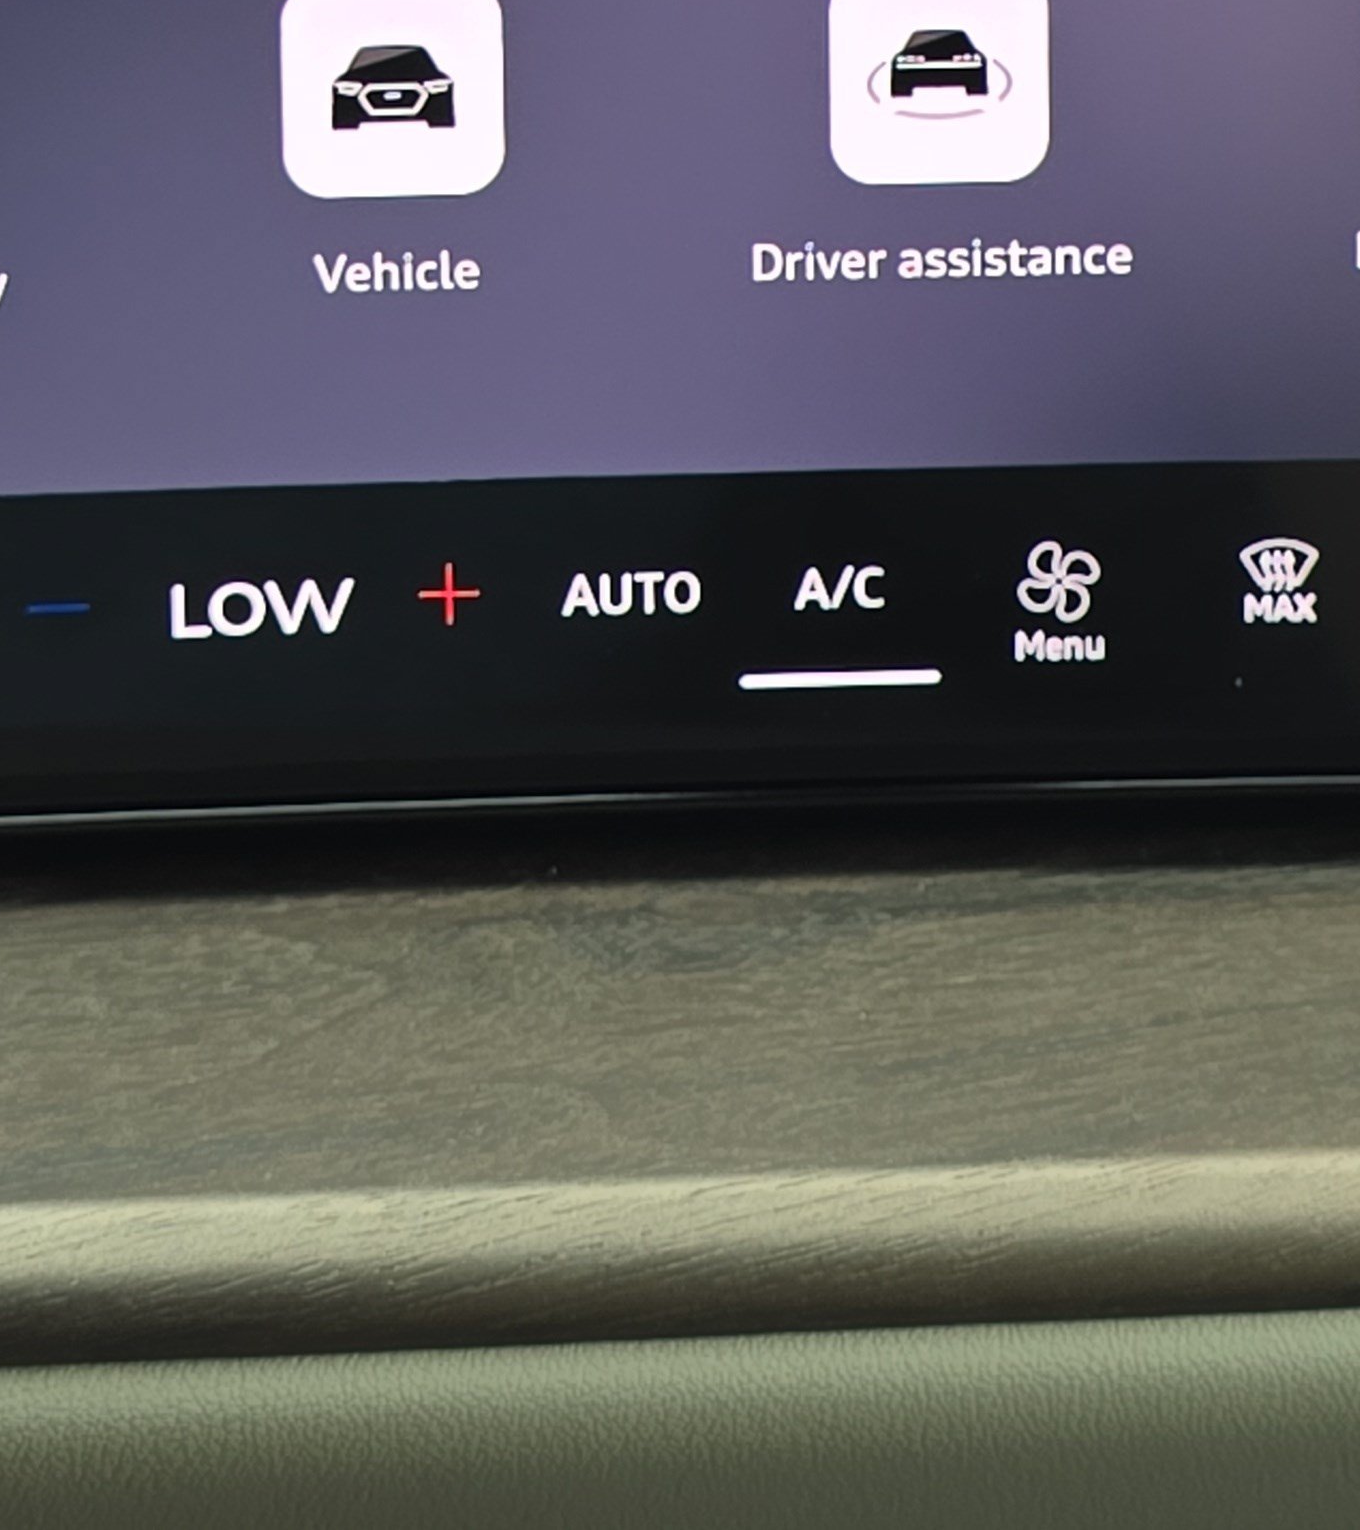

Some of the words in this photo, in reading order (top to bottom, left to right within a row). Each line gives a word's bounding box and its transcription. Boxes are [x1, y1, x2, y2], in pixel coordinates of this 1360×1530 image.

[312, 249, 482, 295] Vehicle
[751, 241, 888, 283] Driver
[896, 237, 1135, 279] assistance
[169, 577, 355, 639] LOW
[560, 570, 702, 619] AUTO
[793, 564, 886, 612] A/C
[1243, 592, 1319, 624] MAX
[1013, 628, 1107, 663] Menu
